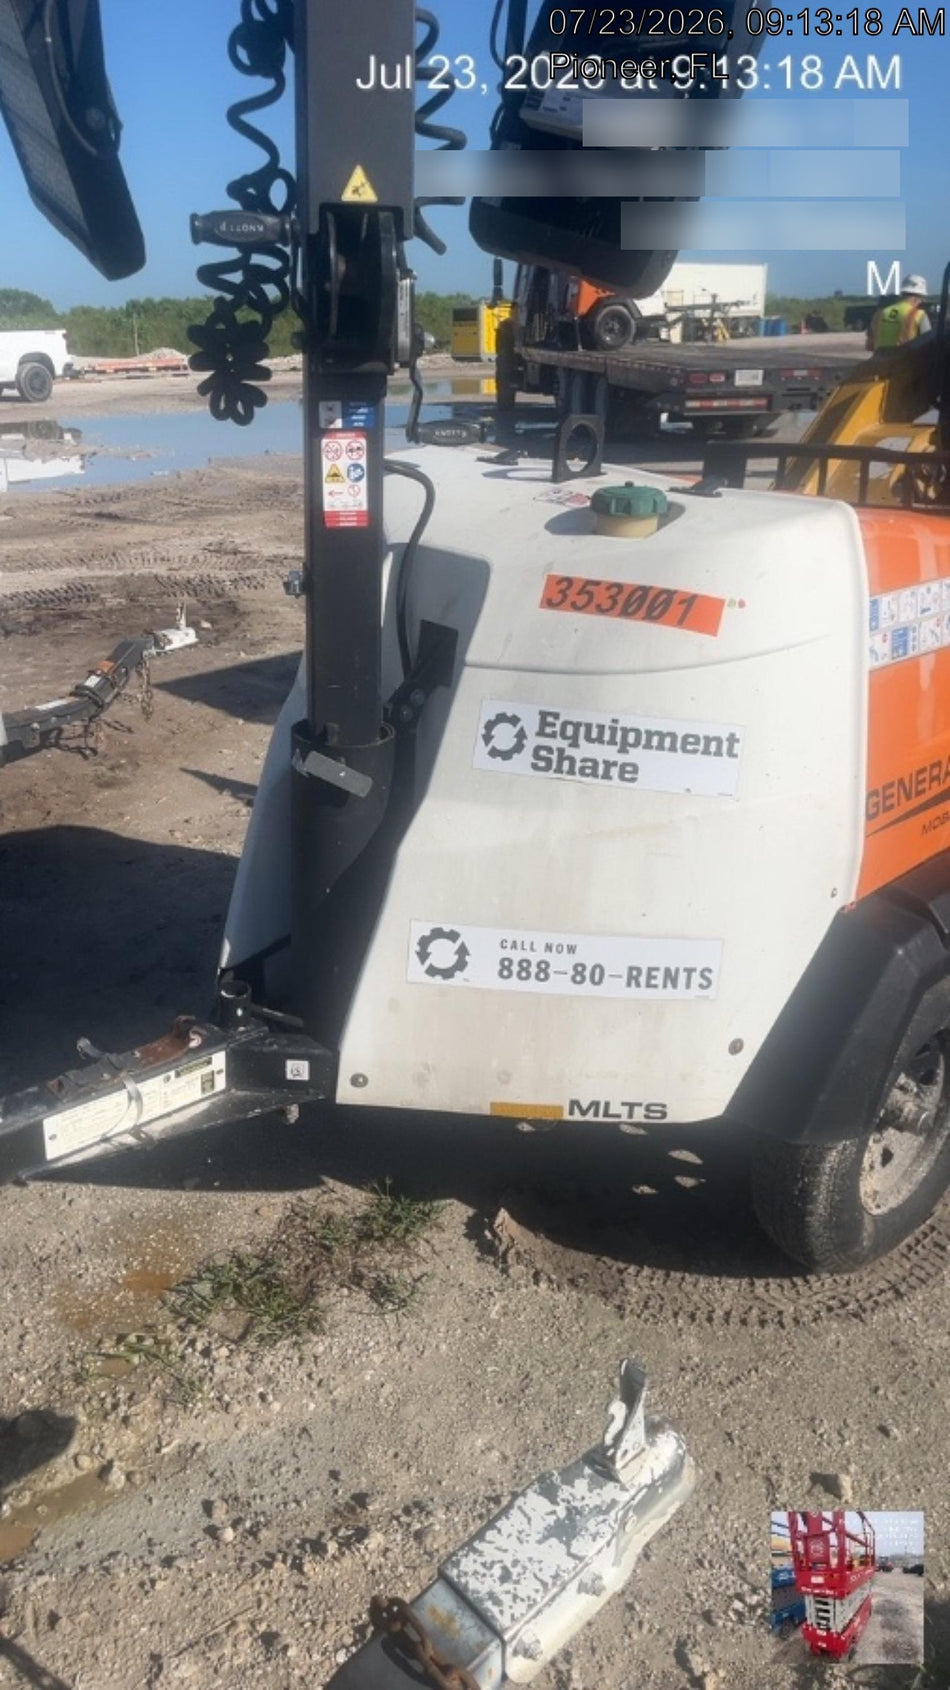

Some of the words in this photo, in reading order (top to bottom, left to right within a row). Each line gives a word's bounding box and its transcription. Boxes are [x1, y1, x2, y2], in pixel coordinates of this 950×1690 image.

[535, 710, 740, 758] Equipment
[531, 744, 639, 783] Share
[500, 939, 536, 952] CALL
[544, 942, 578, 955] NOW
[498, 957, 714, 990] 888-80-RENTS
[568, 1099, 667, 1120] MLTS
